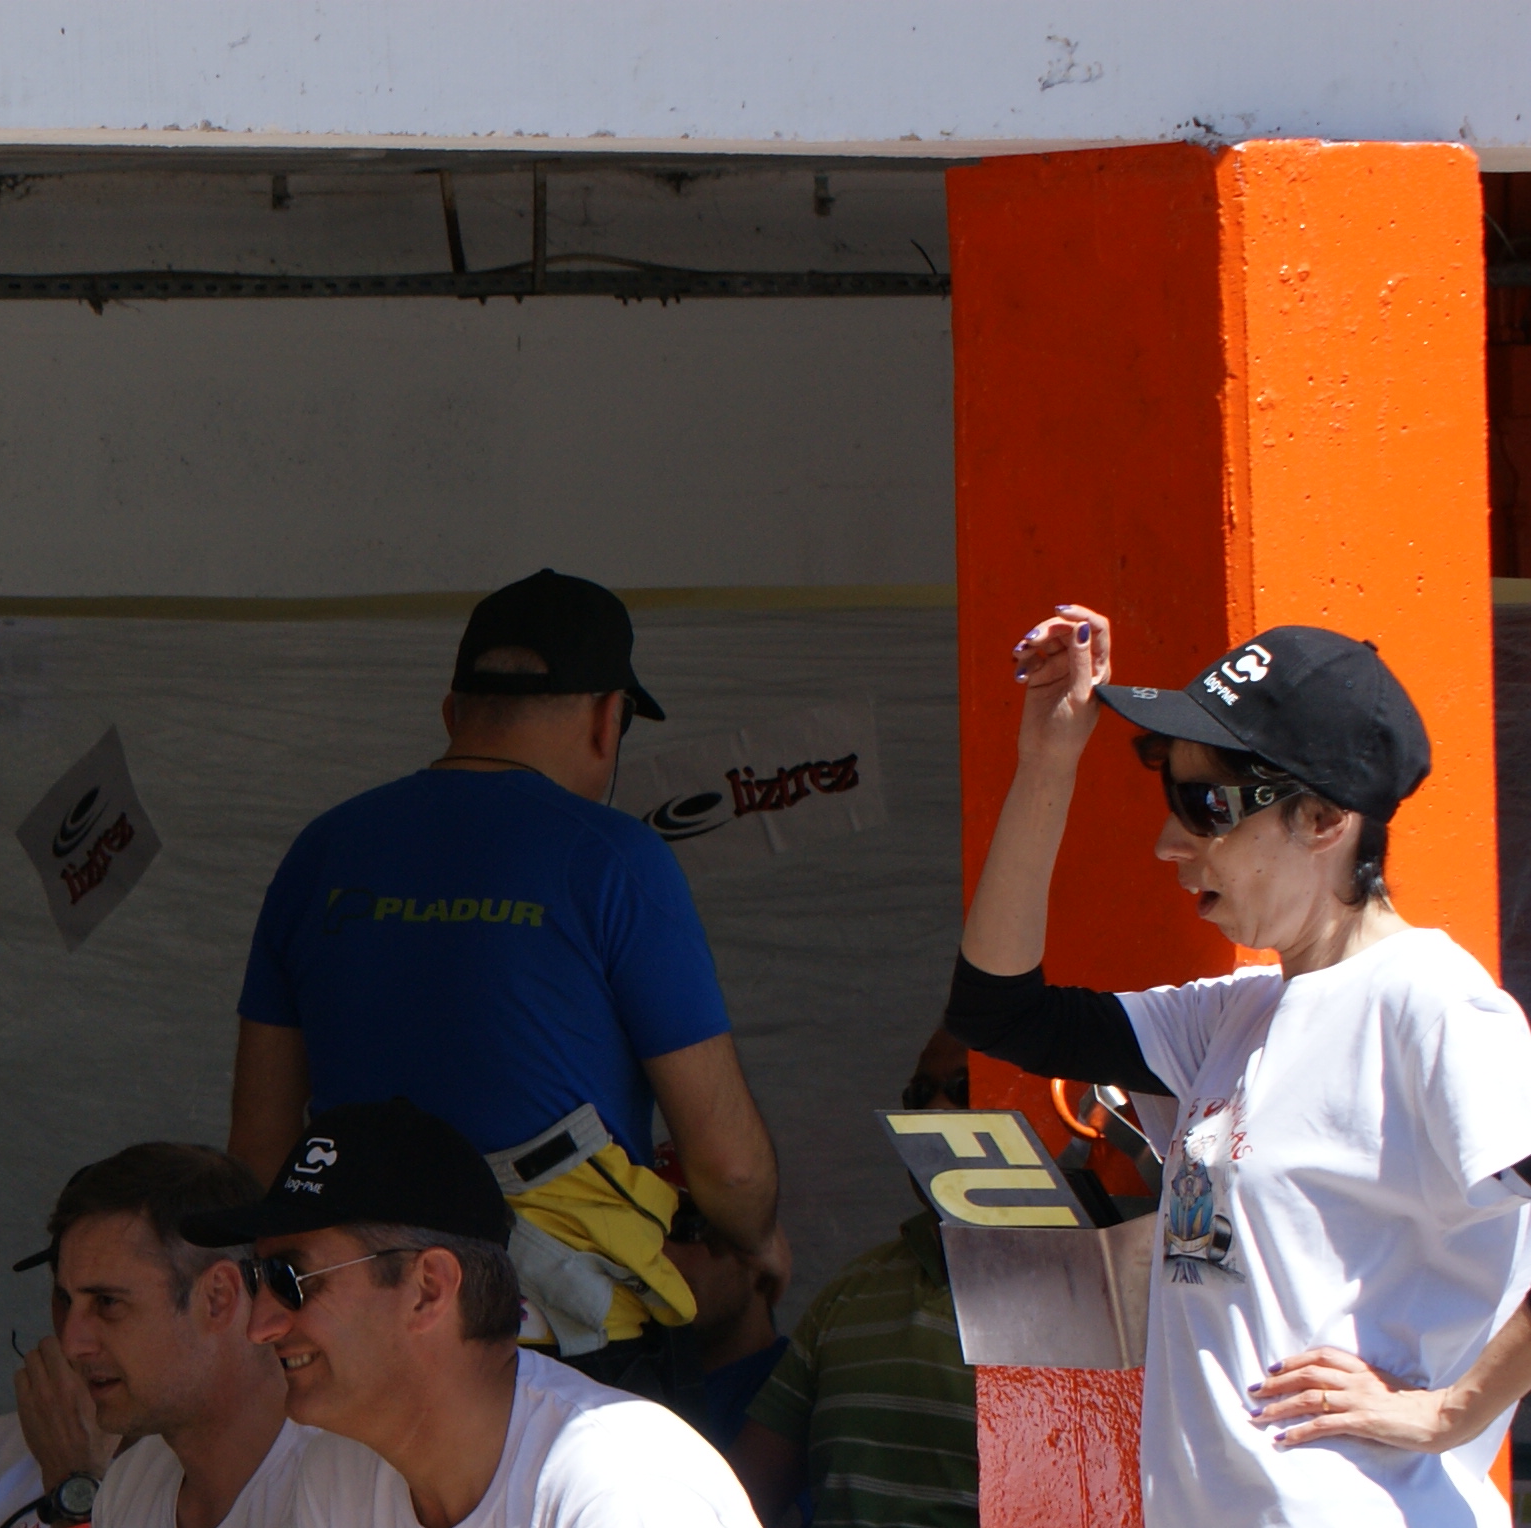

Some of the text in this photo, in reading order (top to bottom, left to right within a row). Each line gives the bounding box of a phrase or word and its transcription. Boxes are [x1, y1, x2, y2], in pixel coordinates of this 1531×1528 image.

[726, 753, 860, 818] liztrez
[60, 811, 136, 905] liztrez
[373, 897, 545, 927] PLADUR
